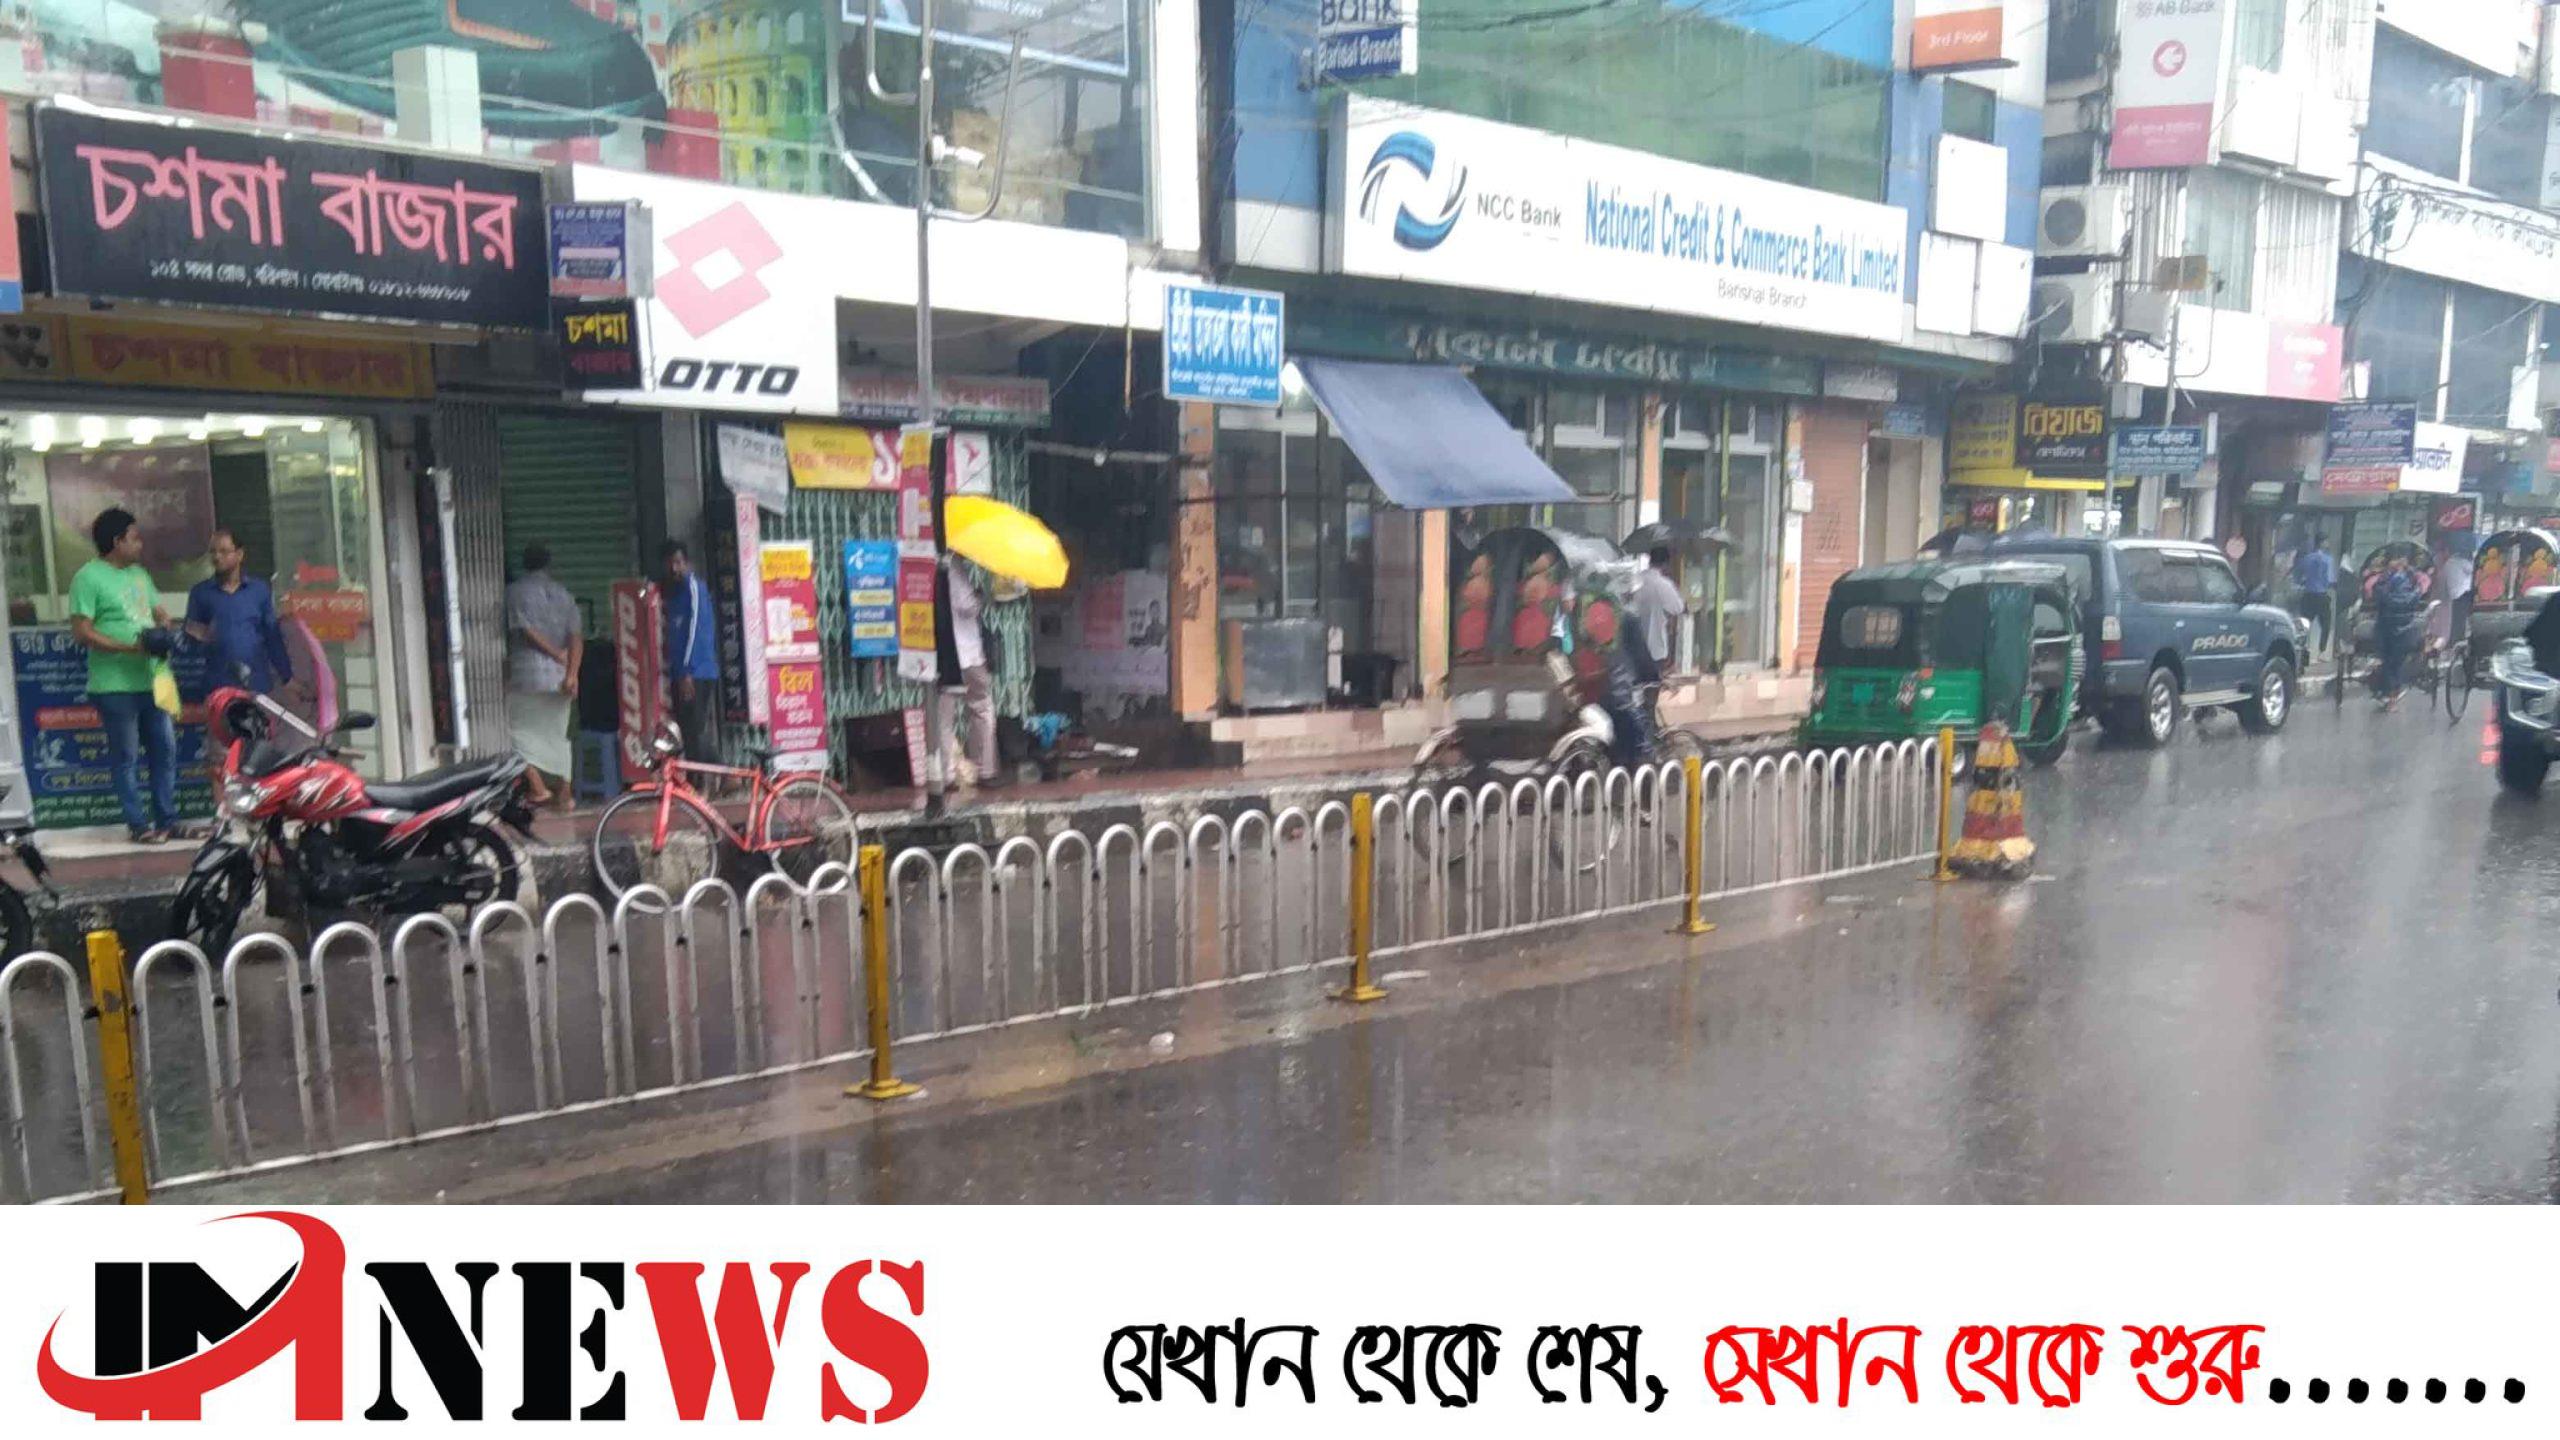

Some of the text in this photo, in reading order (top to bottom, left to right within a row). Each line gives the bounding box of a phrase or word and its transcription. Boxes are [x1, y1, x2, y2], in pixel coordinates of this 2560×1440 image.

[76, 144, 518, 269] চশমা বাজার
[1477, 193, 1562, 228] NCC Bank
[1585, 179, 1899, 294] National Credit & Commerce Bank Limited
[564, 312, 629, 344] চশমা
[659, 357, 801, 396] OTTO
[618, 591, 642, 732] LOTTO
[2192, 634, 2249, 651] PRADO
